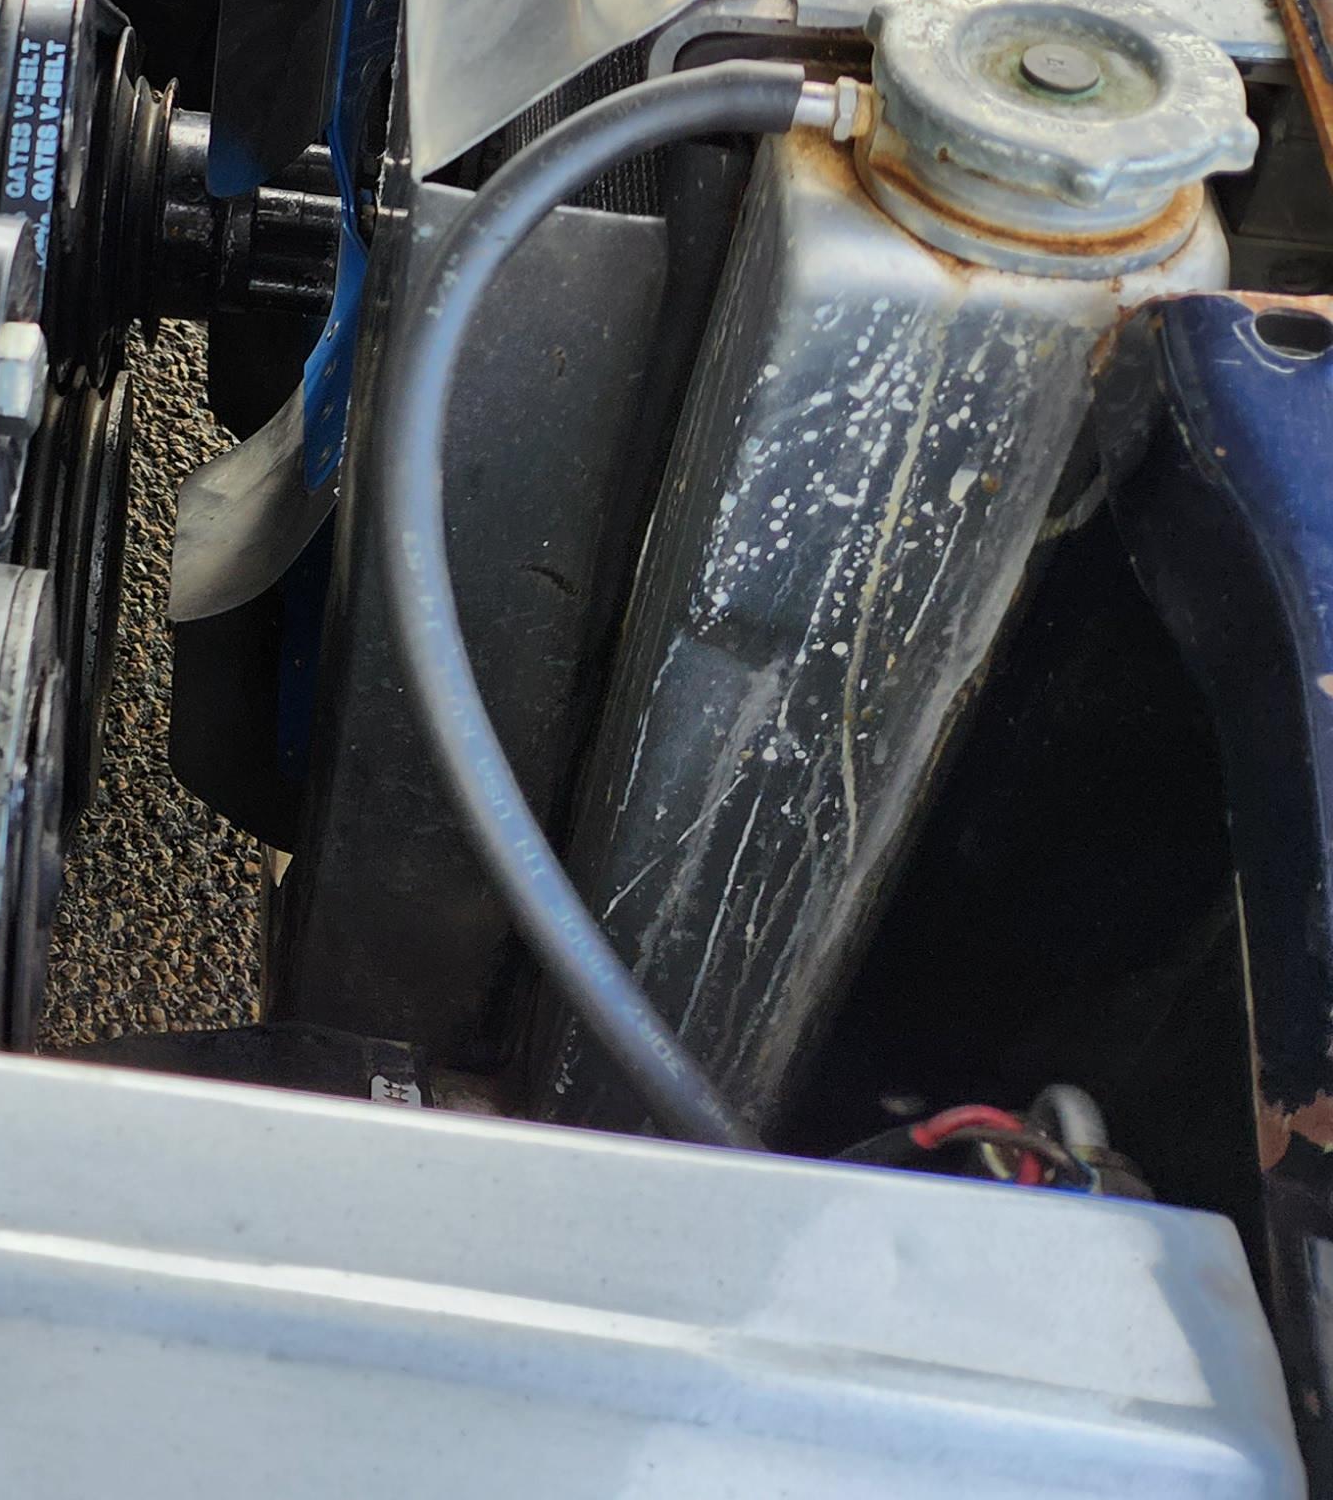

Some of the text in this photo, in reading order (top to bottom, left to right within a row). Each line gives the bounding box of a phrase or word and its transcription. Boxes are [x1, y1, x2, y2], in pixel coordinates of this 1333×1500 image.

[6, 37, 41, 200] GATES V-BELT
[37, 39, 66, 122] V-BELT
[31, 123, 58, 202] GATES
